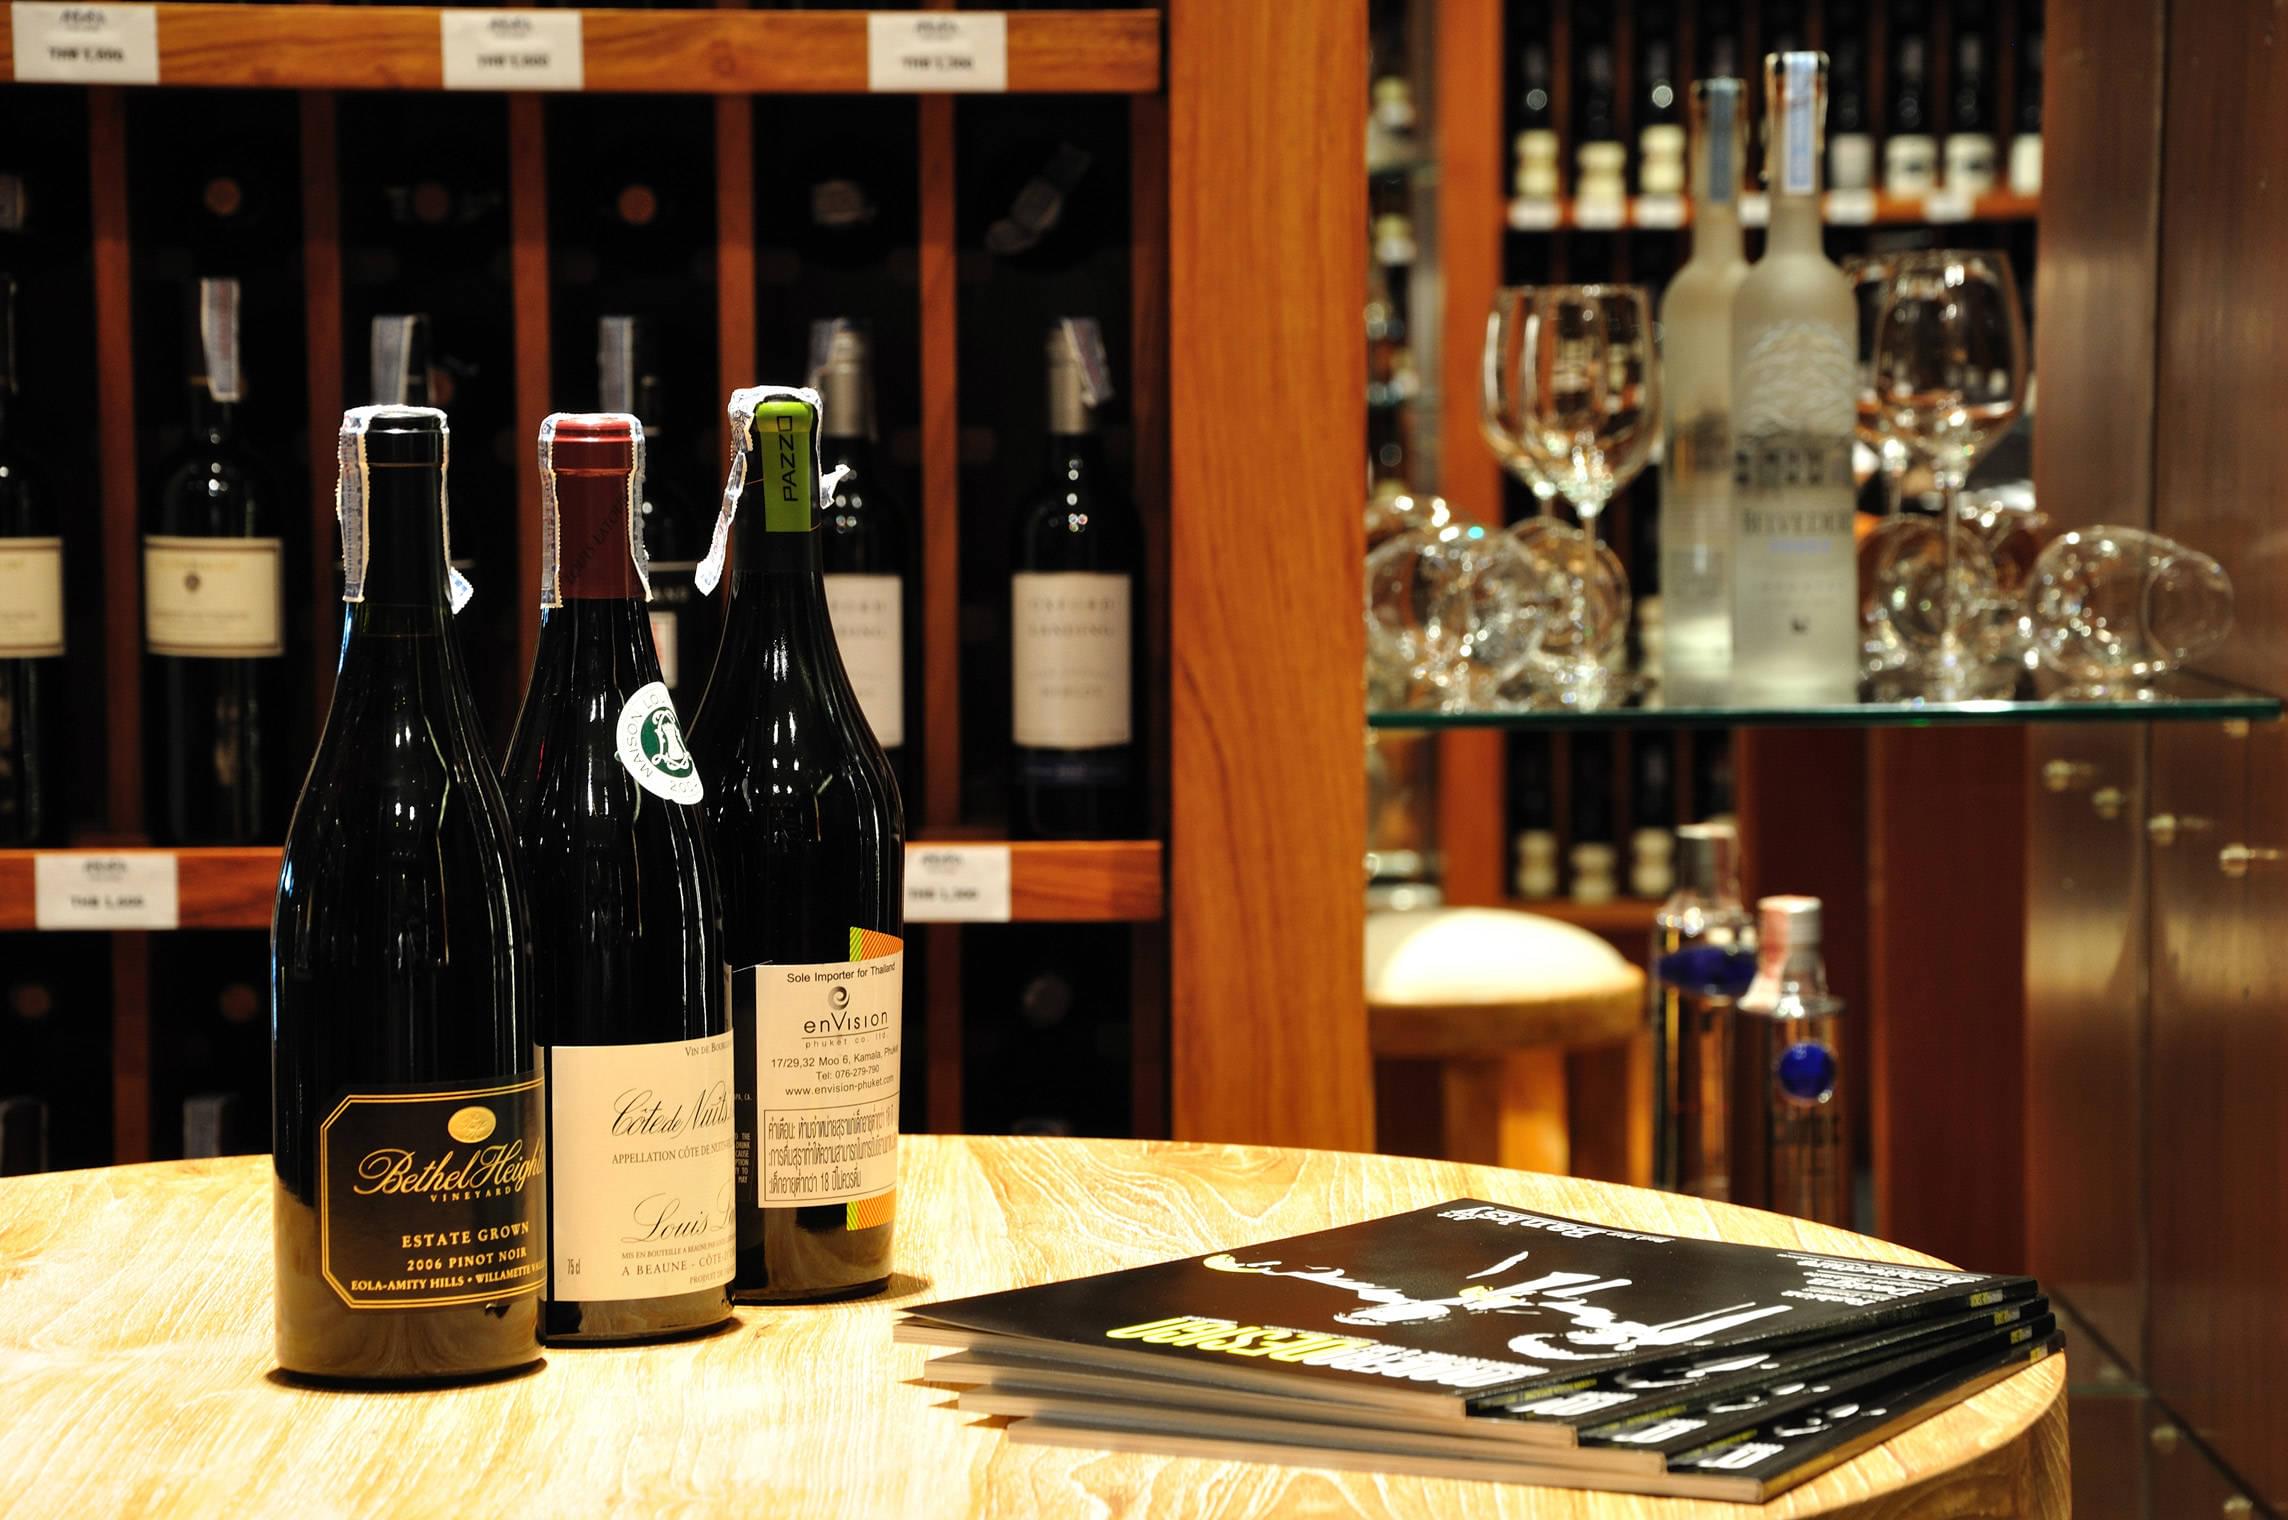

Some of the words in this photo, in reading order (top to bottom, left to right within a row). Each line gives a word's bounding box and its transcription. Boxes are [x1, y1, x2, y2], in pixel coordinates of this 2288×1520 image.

[777, 415, 799, 502] PAZZO
[626, 713, 654, 778] MAISON
[786, 973, 811, 983] Sole
[814, 970, 855, 983] Importer
[857, 967, 868, 978] for
[870, 962, 896, 976] Thailand
[685, 1047, 699, 1057] VIN
[805, 1038, 847, 1048] phuket
[771, 1058, 815, 1069] 17/29,32
[818, 1056, 840, 1066] Moo
[842, 1055, 851, 1065] 6,
[816, 1071, 832, 1081] Tel:
[834, 1064, 880, 1080] 076-279-790
[785, 1074, 895, 1096] www.envision-phuket.com
[611, 1088, 665, 1137] Côte
[660, 1104, 683, 1134] de
[612, 1149, 676, 1165] APPELLATION
[678, 1144, 700, 1160] CÔTE
[353, 1148, 482, 1195] Bethel
[820, 1172, 829, 1192] 18
[430, 1186, 512, 1204] VINEYARD
[620, 1192, 709, 1243] Louis
[1462, 1206, 1601, 1238] Banksy
[402, 1230, 471, 1249] ESTATE
[478, 1220, 529, 1242] GROWN
[406, 1258, 443, 1272] 2006
[448, 1252, 494, 1269] PINOT
[498, 1246, 527, 1263] NOIR
[621, 1251, 635, 1260] MIS
[636, 1250, 646, 1259] EN
[647, 1247, 681, 1258] BOUTEILLE
[351, 1275, 427, 1292] EOLA-AMITY
[430, 1275, 465, 1289] HILLS
[475, 1264, 532, 1284] WILLAMETTE
[621, 1266, 630, 1276] A
[636, 1260, 688, 1276] BEAUNE
